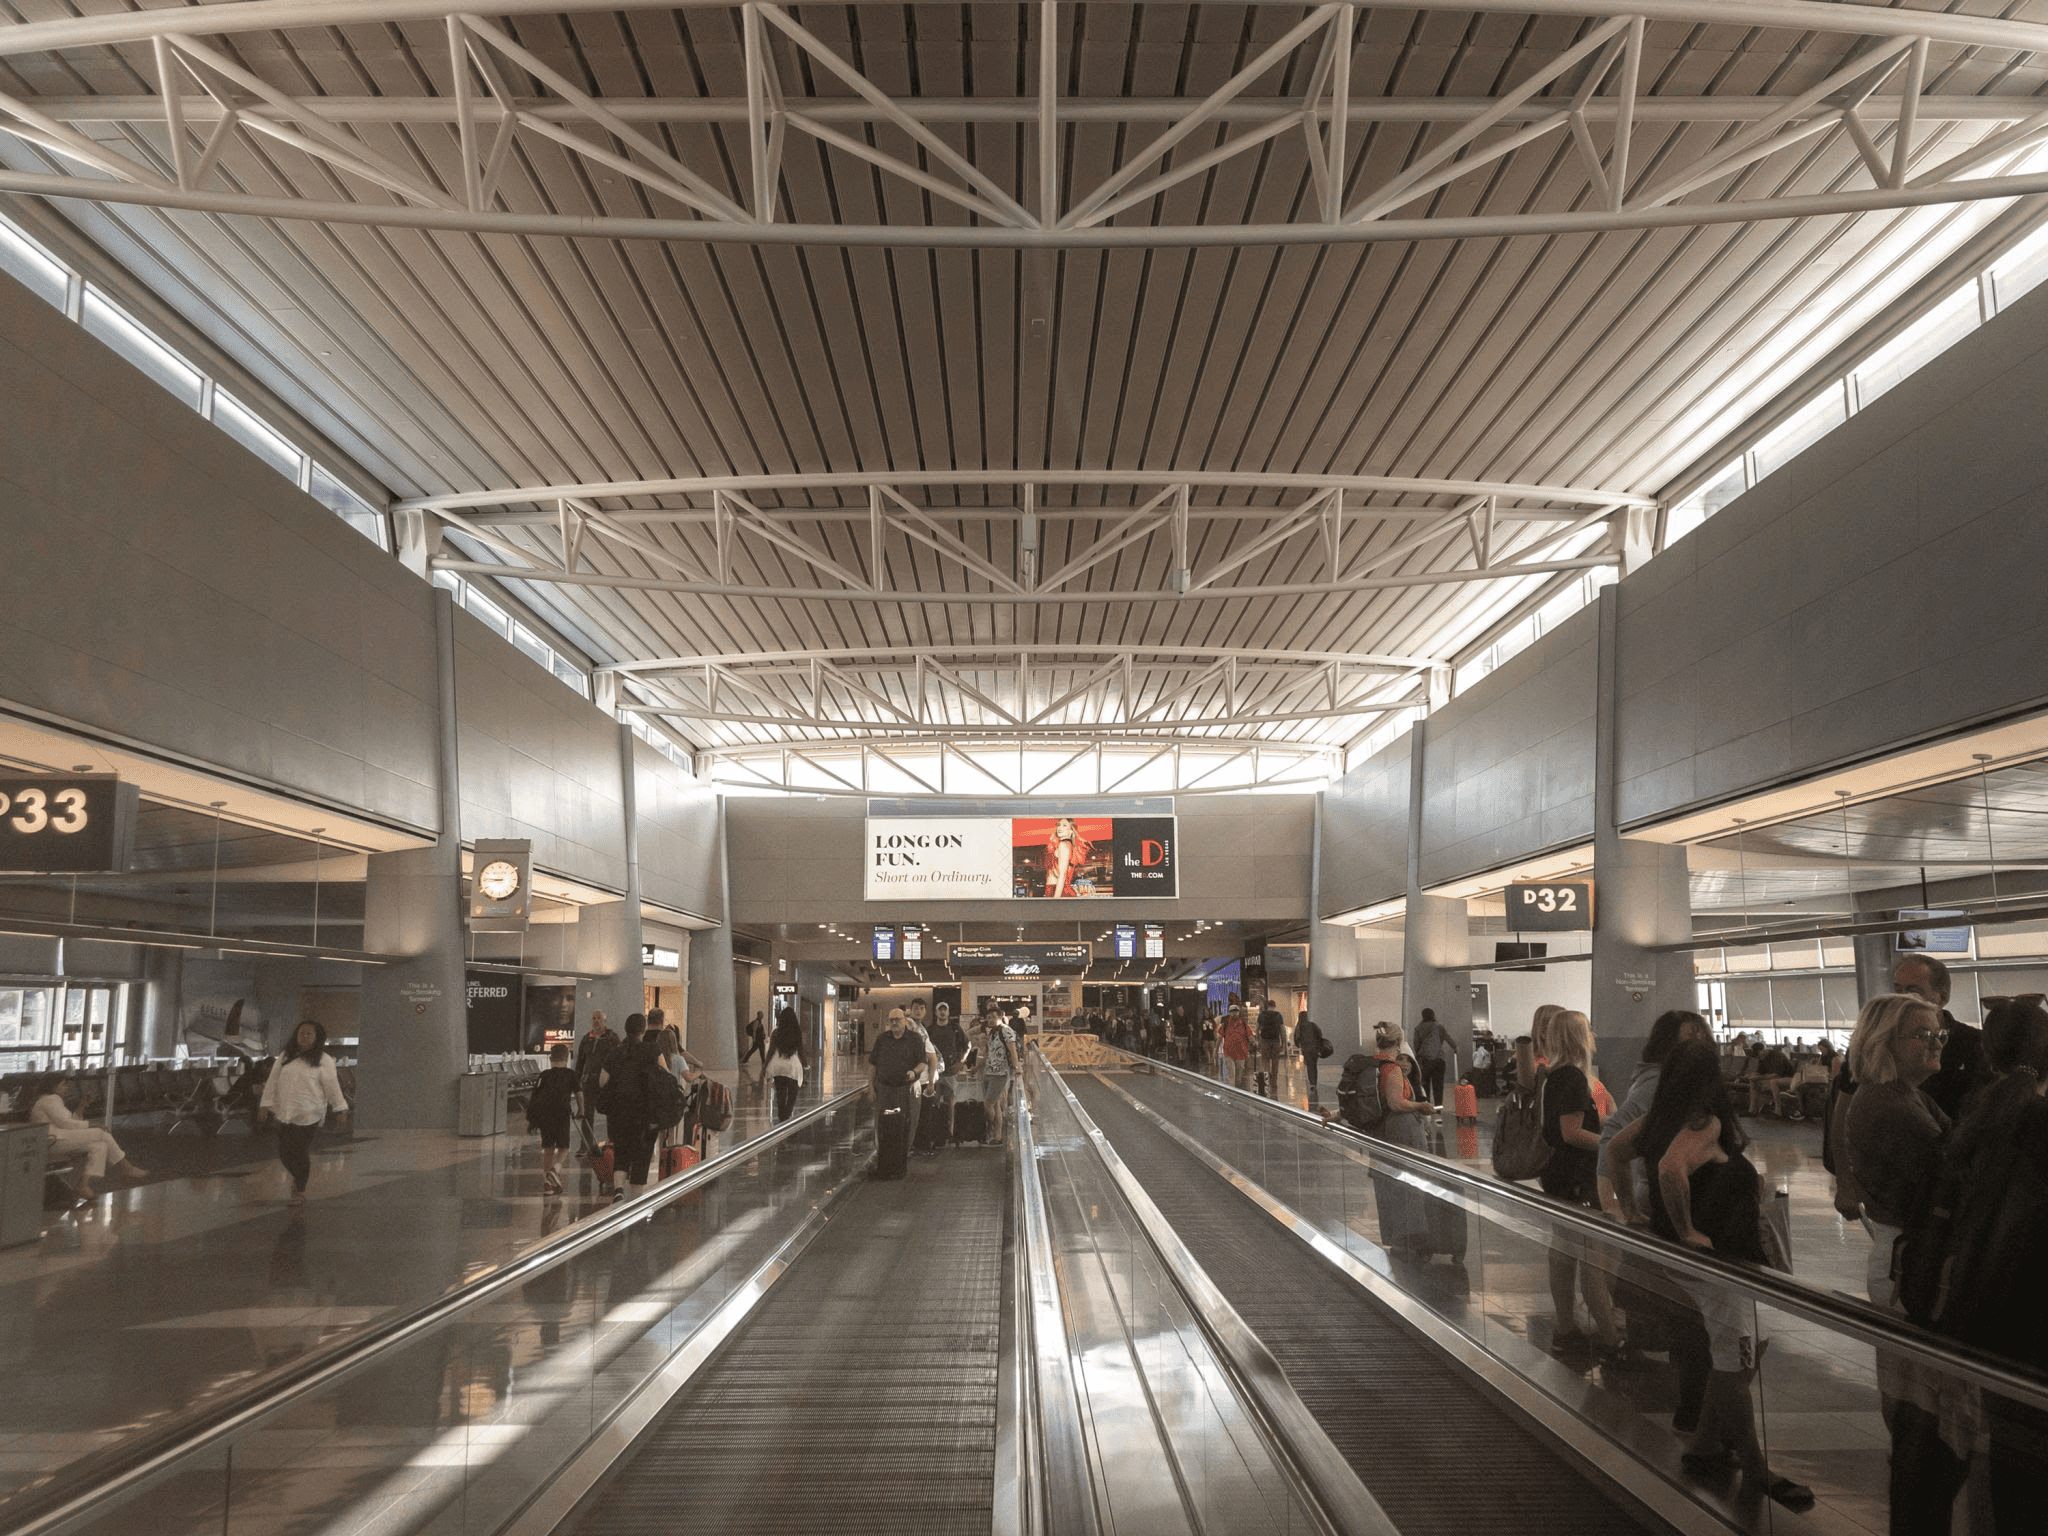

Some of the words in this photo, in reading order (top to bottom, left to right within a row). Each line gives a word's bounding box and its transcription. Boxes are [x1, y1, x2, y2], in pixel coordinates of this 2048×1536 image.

[876, 835, 930, 849] LONG
[935, 835, 963, 848] ON
[876, 853, 920, 866] FUN.
[1125, 852, 1140, 866] the
[1141, 839, 1164, 867] D
[875, 871, 909, 883] Short
[912, 874, 927, 882] on
[931, 870, 992, 885] Ordinary.
[1523, 888, 1577, 912] D32
